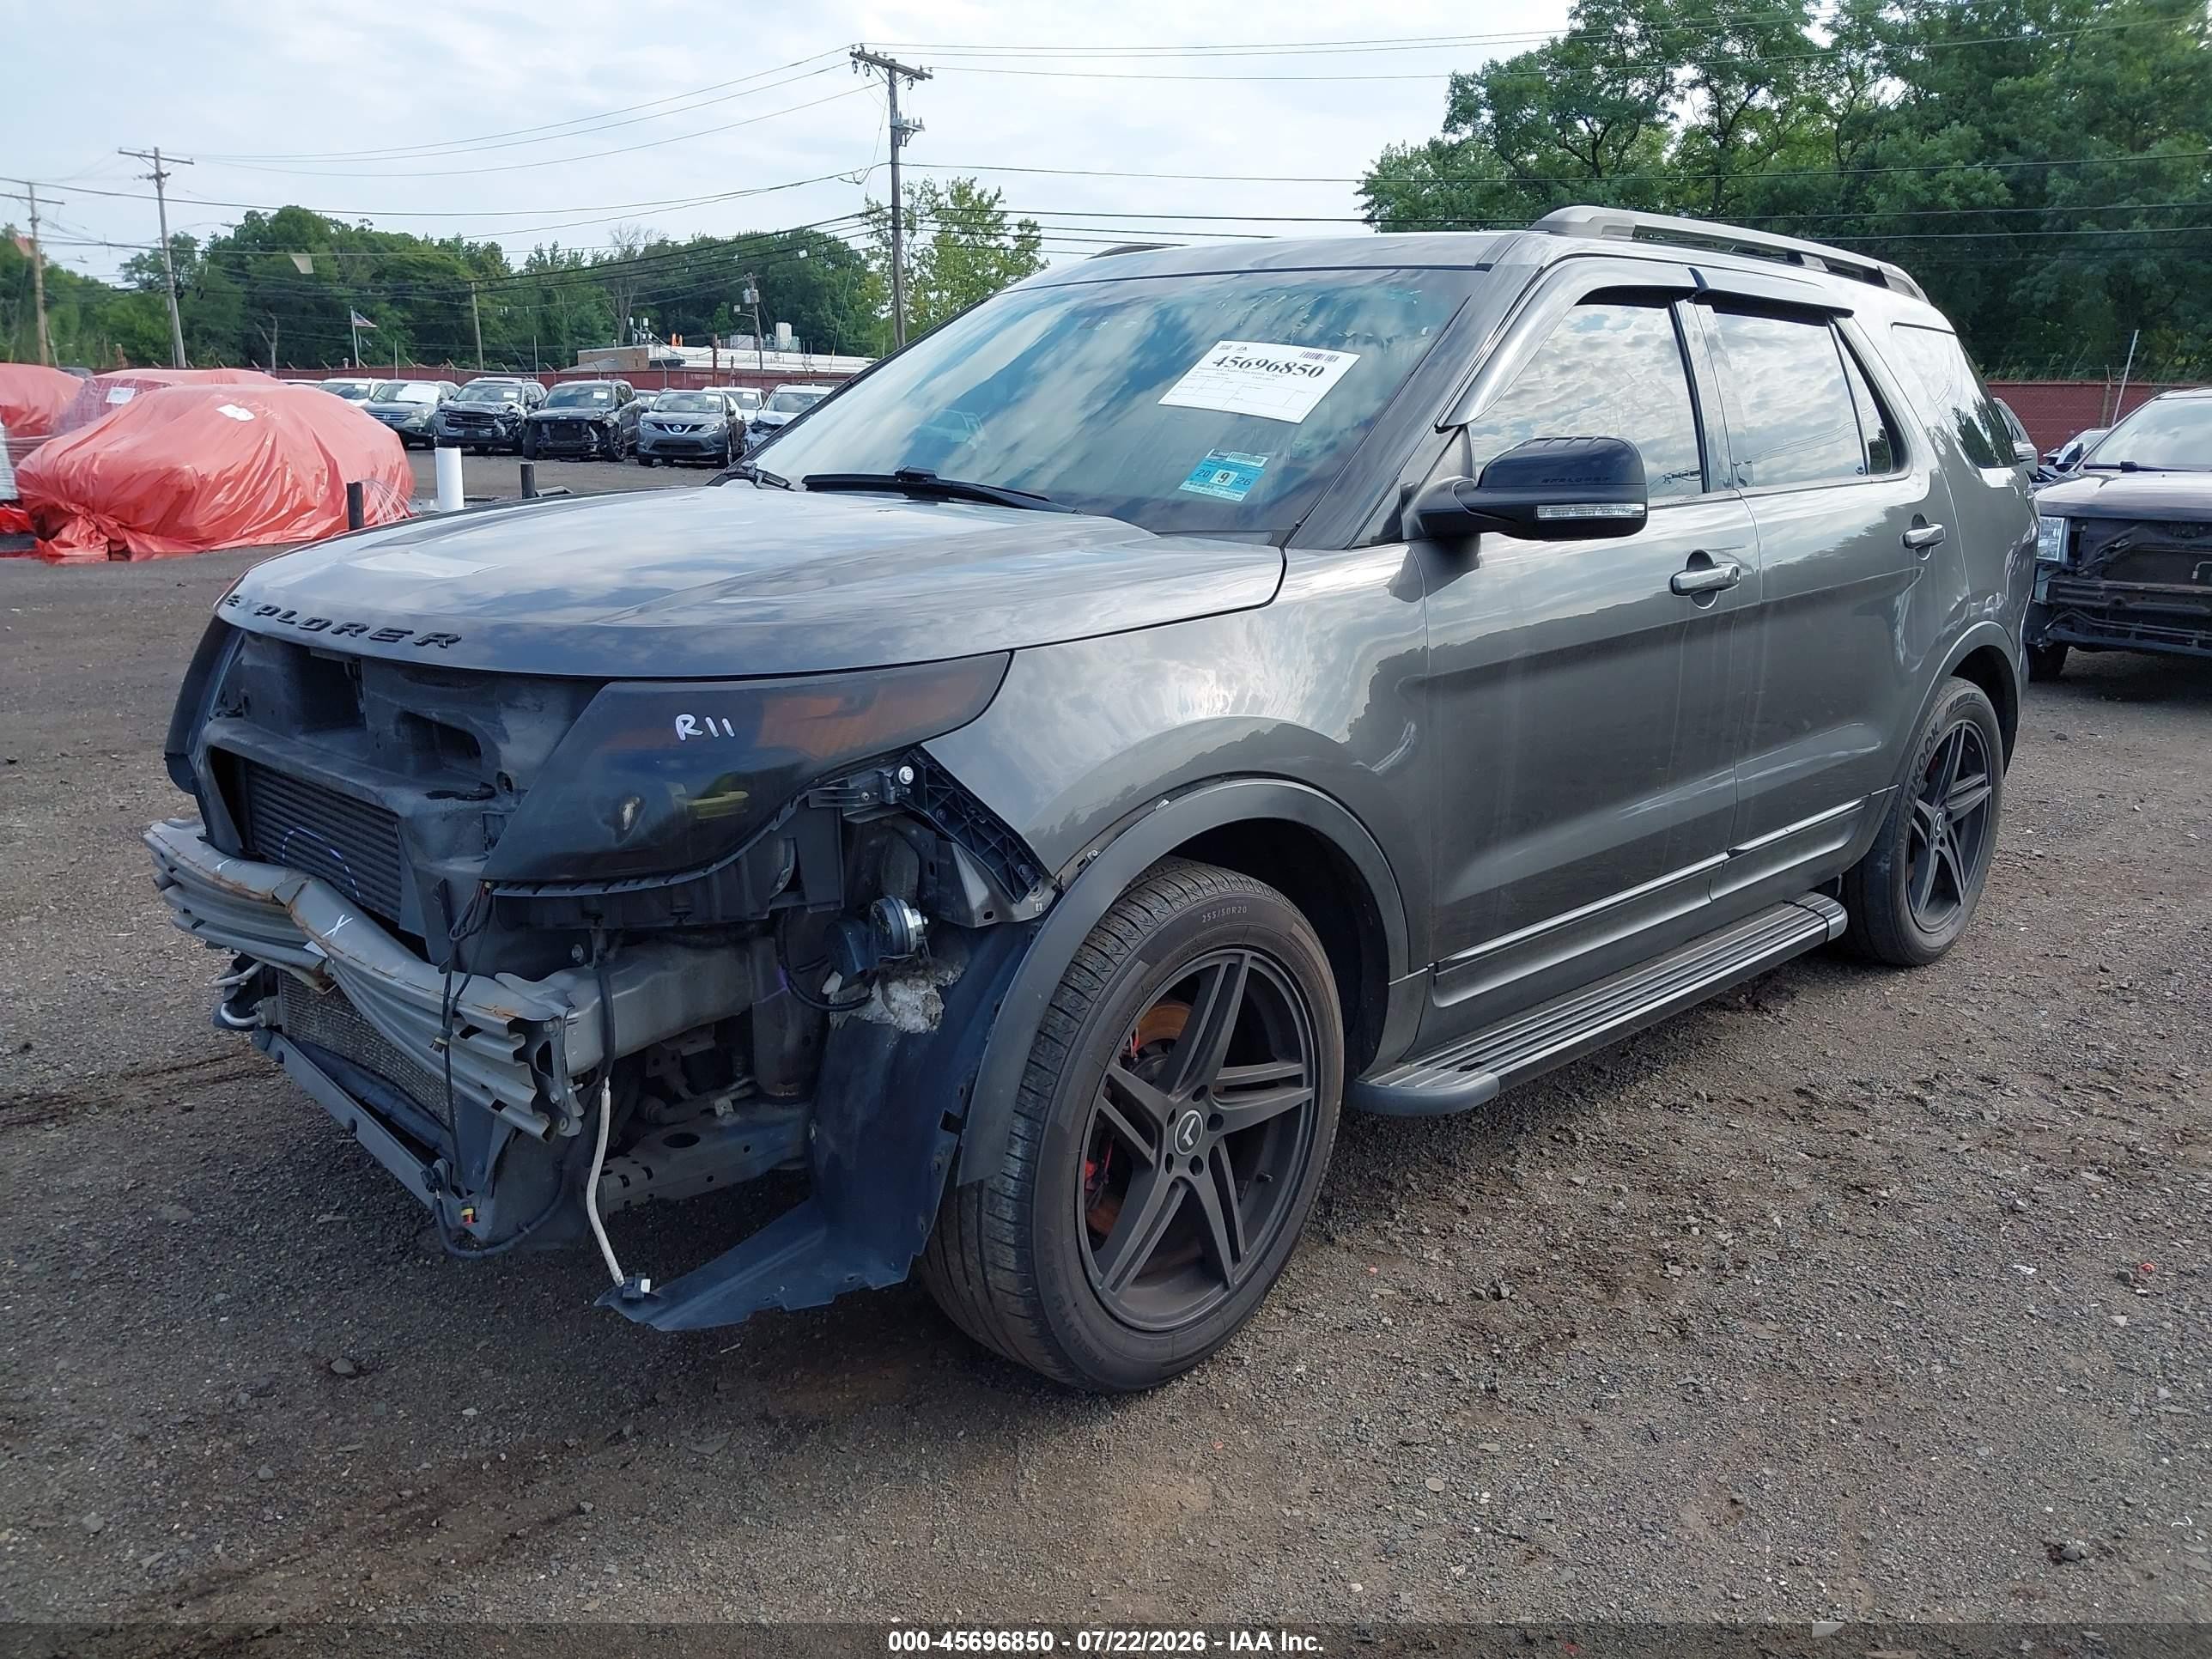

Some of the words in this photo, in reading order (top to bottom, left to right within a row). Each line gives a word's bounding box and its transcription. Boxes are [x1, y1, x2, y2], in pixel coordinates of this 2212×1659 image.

[1212, 355, 1326, 380] 45696850
[1195, 468, 1212, 478] 20
[1217, 471, 1231, 483] 9
[1236, 476, 1253, 486] 26
[224, 592, 463, 649] EXPLORER
[675, 714, 736, 741] R11
[1201, 904, 1248, 924] 255/50R20
